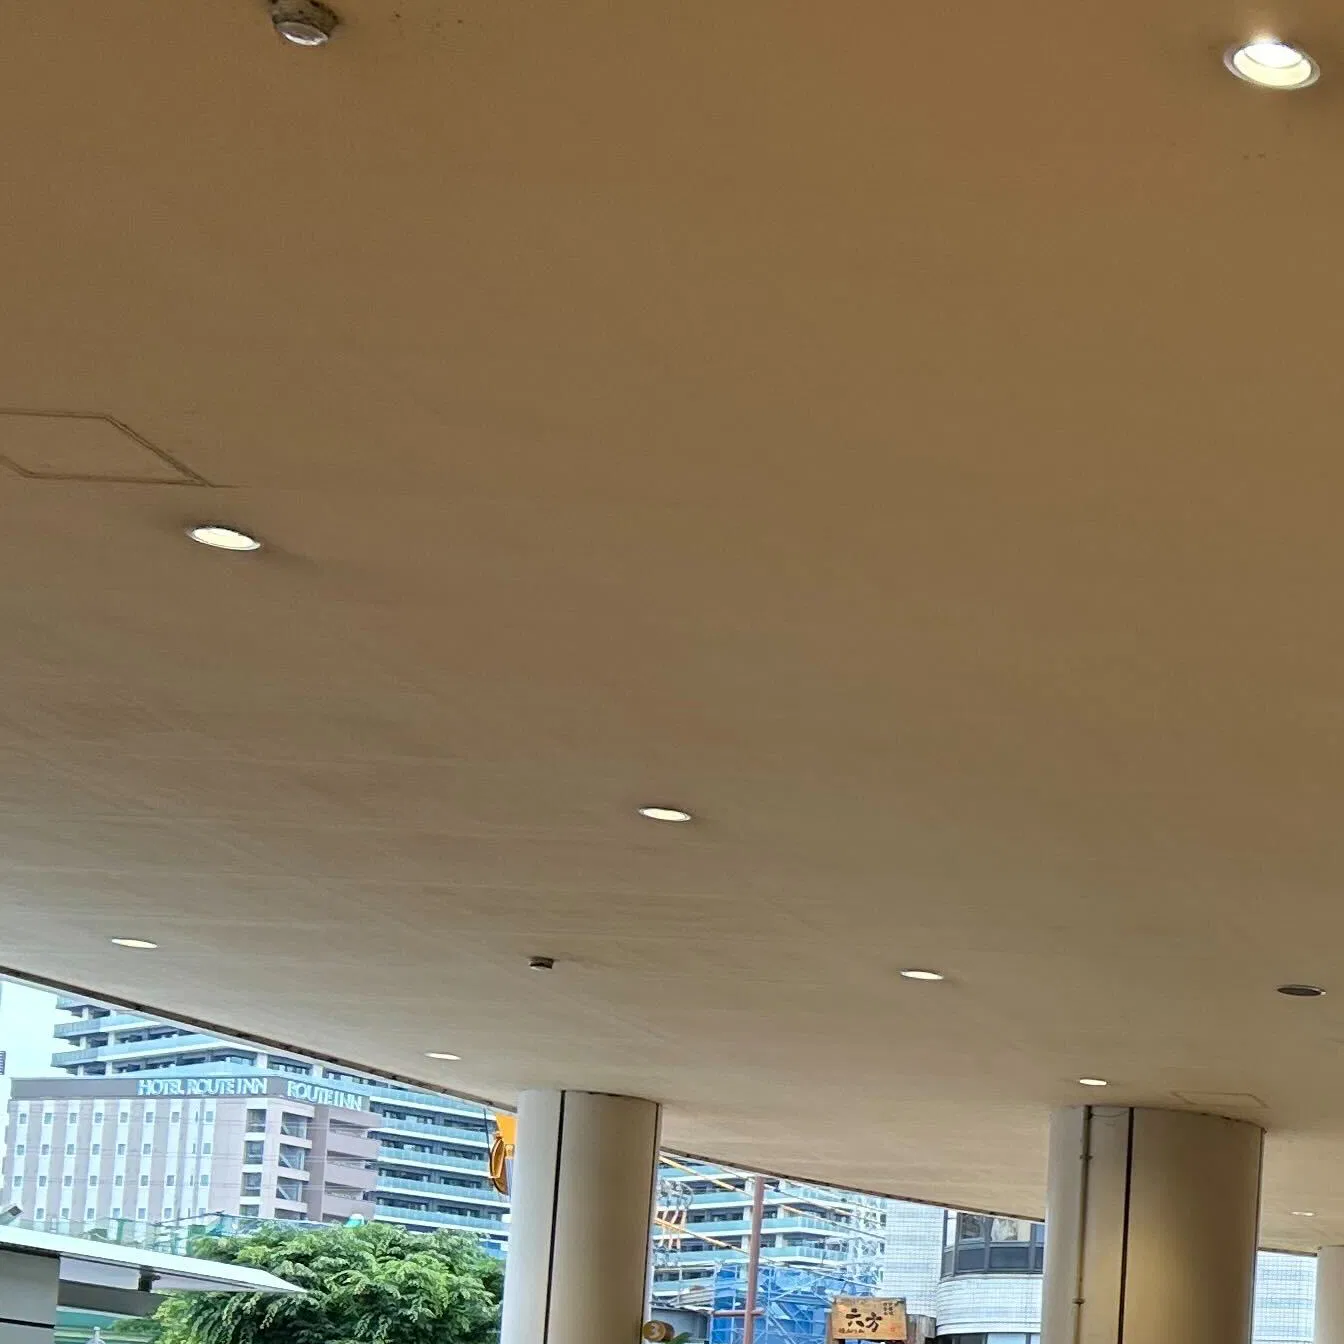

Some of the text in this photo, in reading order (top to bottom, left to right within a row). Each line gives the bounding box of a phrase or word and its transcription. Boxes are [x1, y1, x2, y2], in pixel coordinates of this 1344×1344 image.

[138, 1077, 268, 1096] HOTEL ROUTE INN
[845, 1308, 883, 1333] 六方
